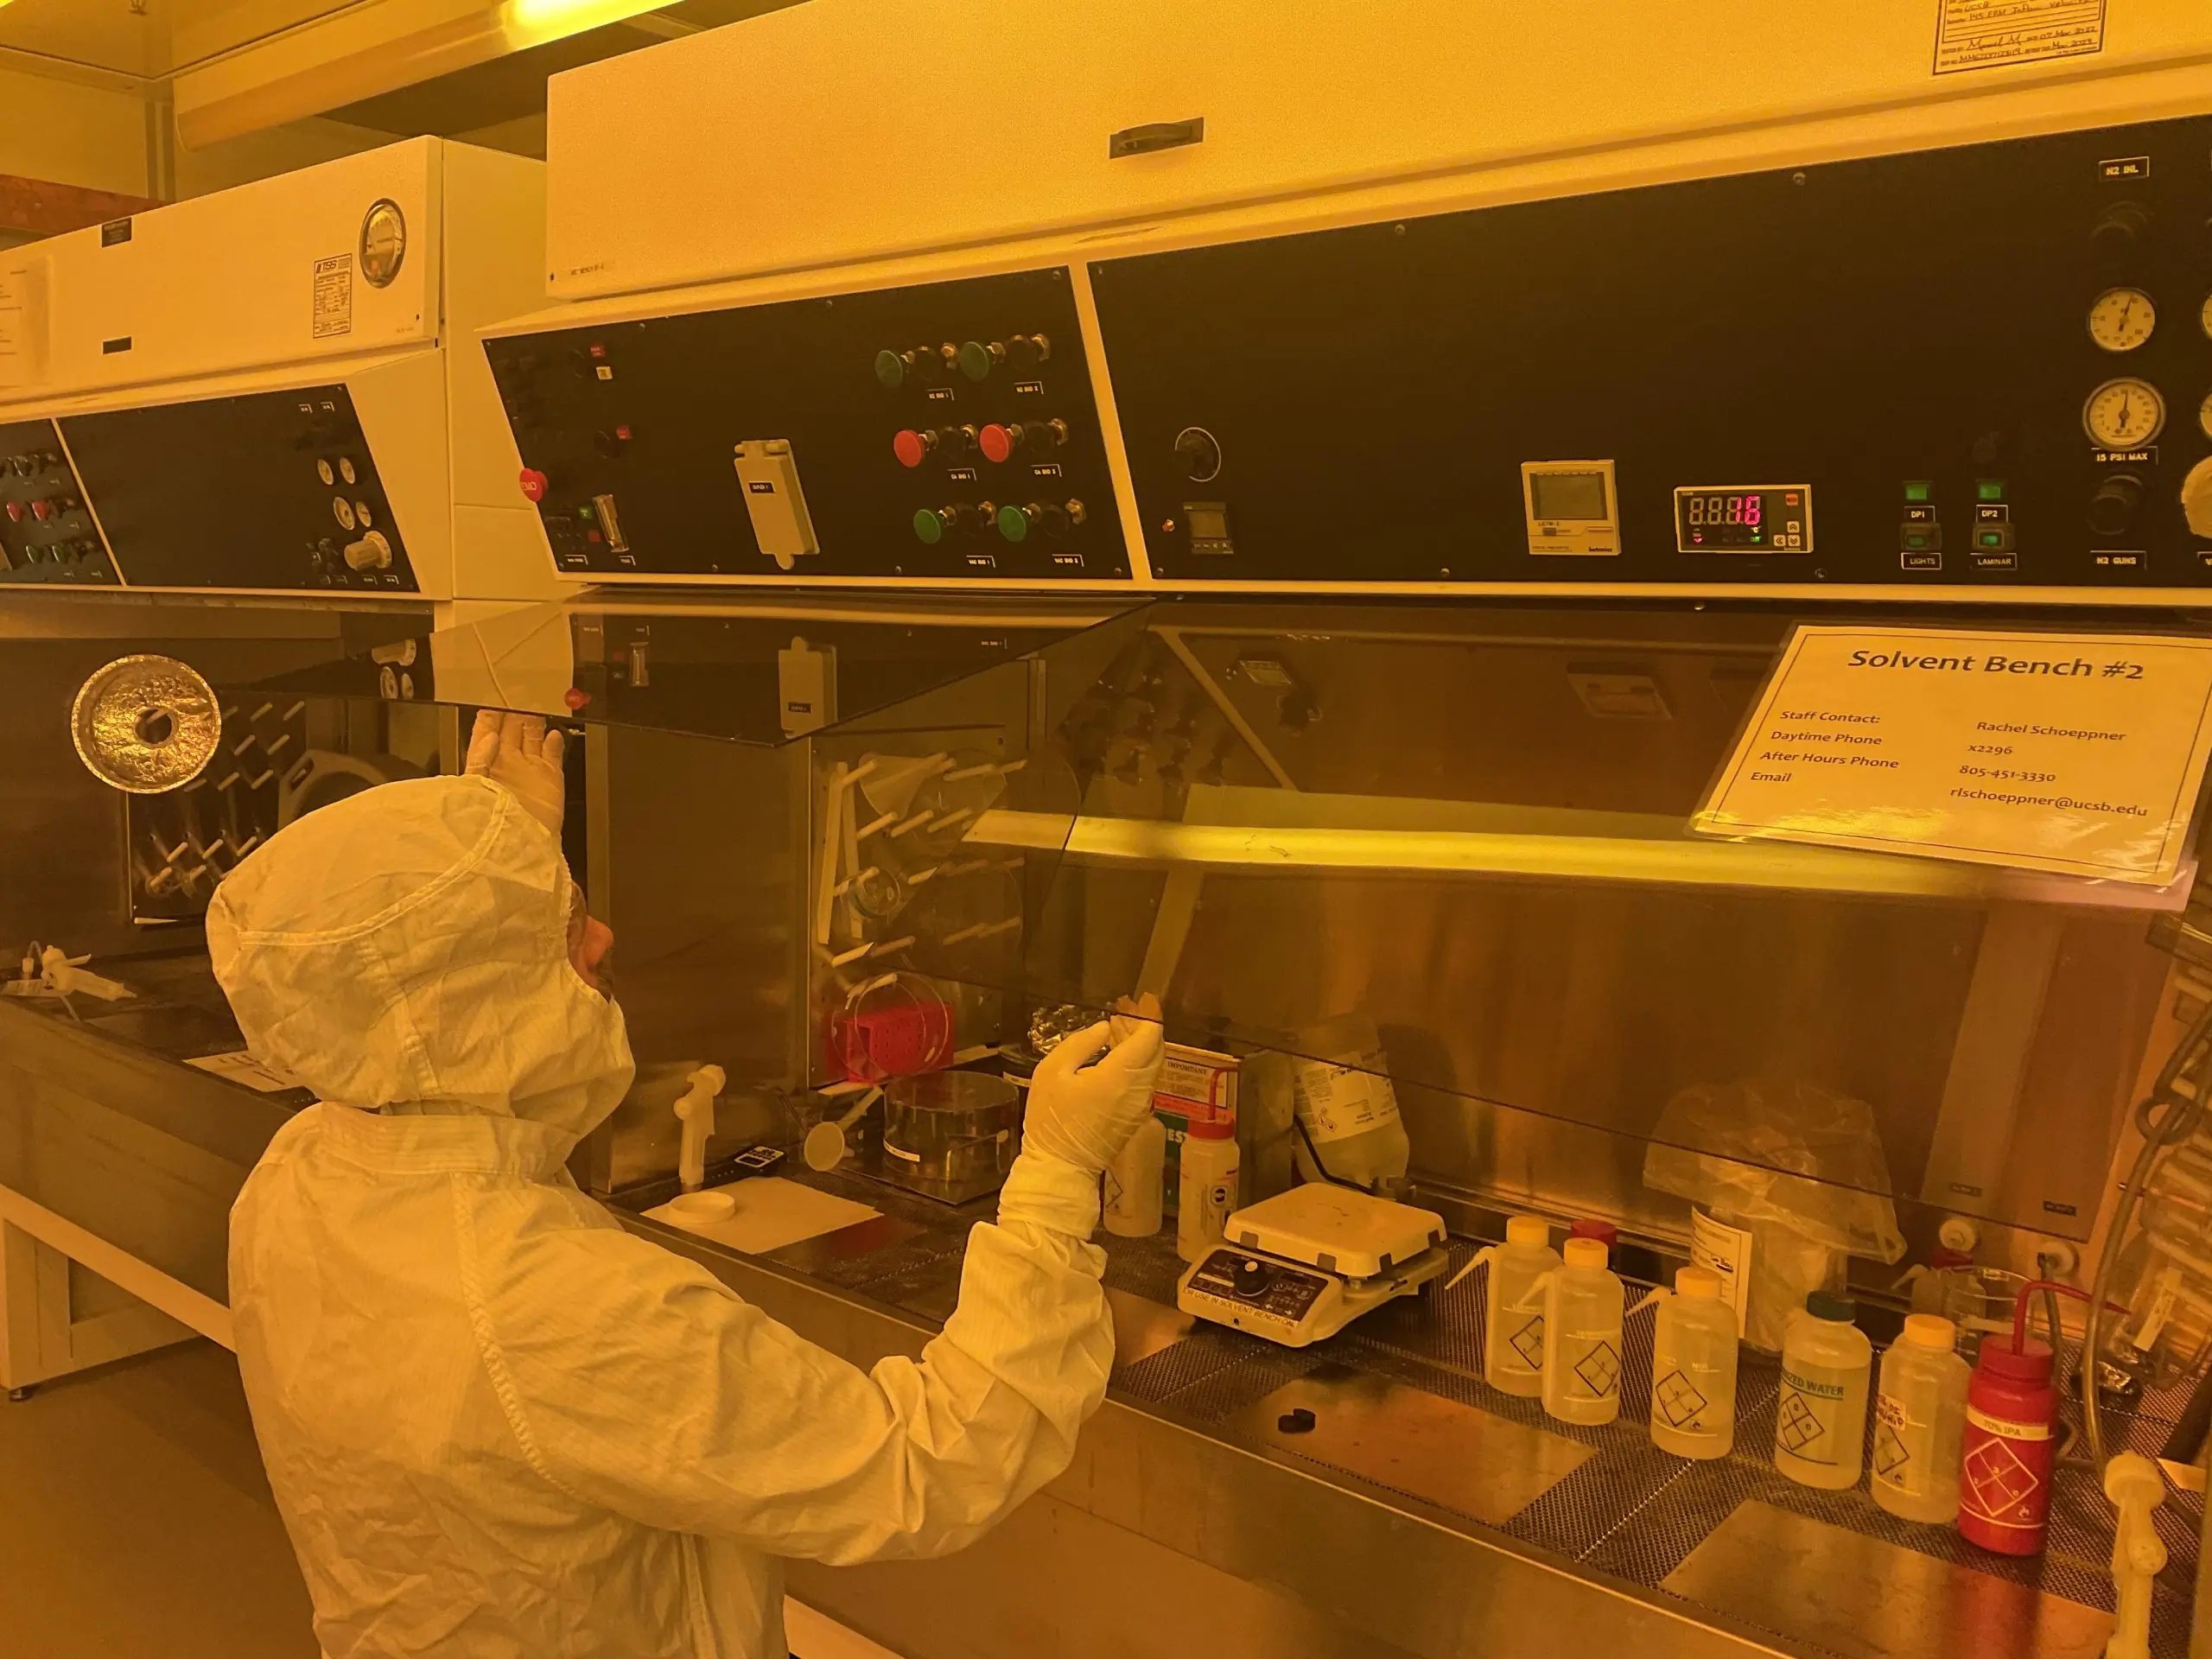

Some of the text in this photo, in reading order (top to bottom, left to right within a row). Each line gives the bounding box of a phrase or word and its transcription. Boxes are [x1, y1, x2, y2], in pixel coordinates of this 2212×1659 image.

[2106, 166, 2120, 175] N2
[2110, 453, 2126, 461] PSI
[1848, 650, 2145, 680] Solvent Bench #2
[1780, 710, 1881, 725] Staff Contact:
[1770, 731, 1883, 745] Daytime Phone
[1977, 721, 2126, 741] Rachel Schoeppner
[1967, 745, 2013, 755] x2296
[1760, 751, 1899, 769] After Hours Phone
[1751, 772, 1791, 783] Email
[1960, 766, 2056, 783] 805-451-3330
[1949, 787, 2148, 817] rlschoeppner@ucsb.edu
[1167, 1061, 1207, 1075] IMPORTANT
[1254, 1310, 1281, 1323] BENCH
[1807, 1380, 1844, 1396] WATER
[2004, 1425, 2021, 1436] IPA
